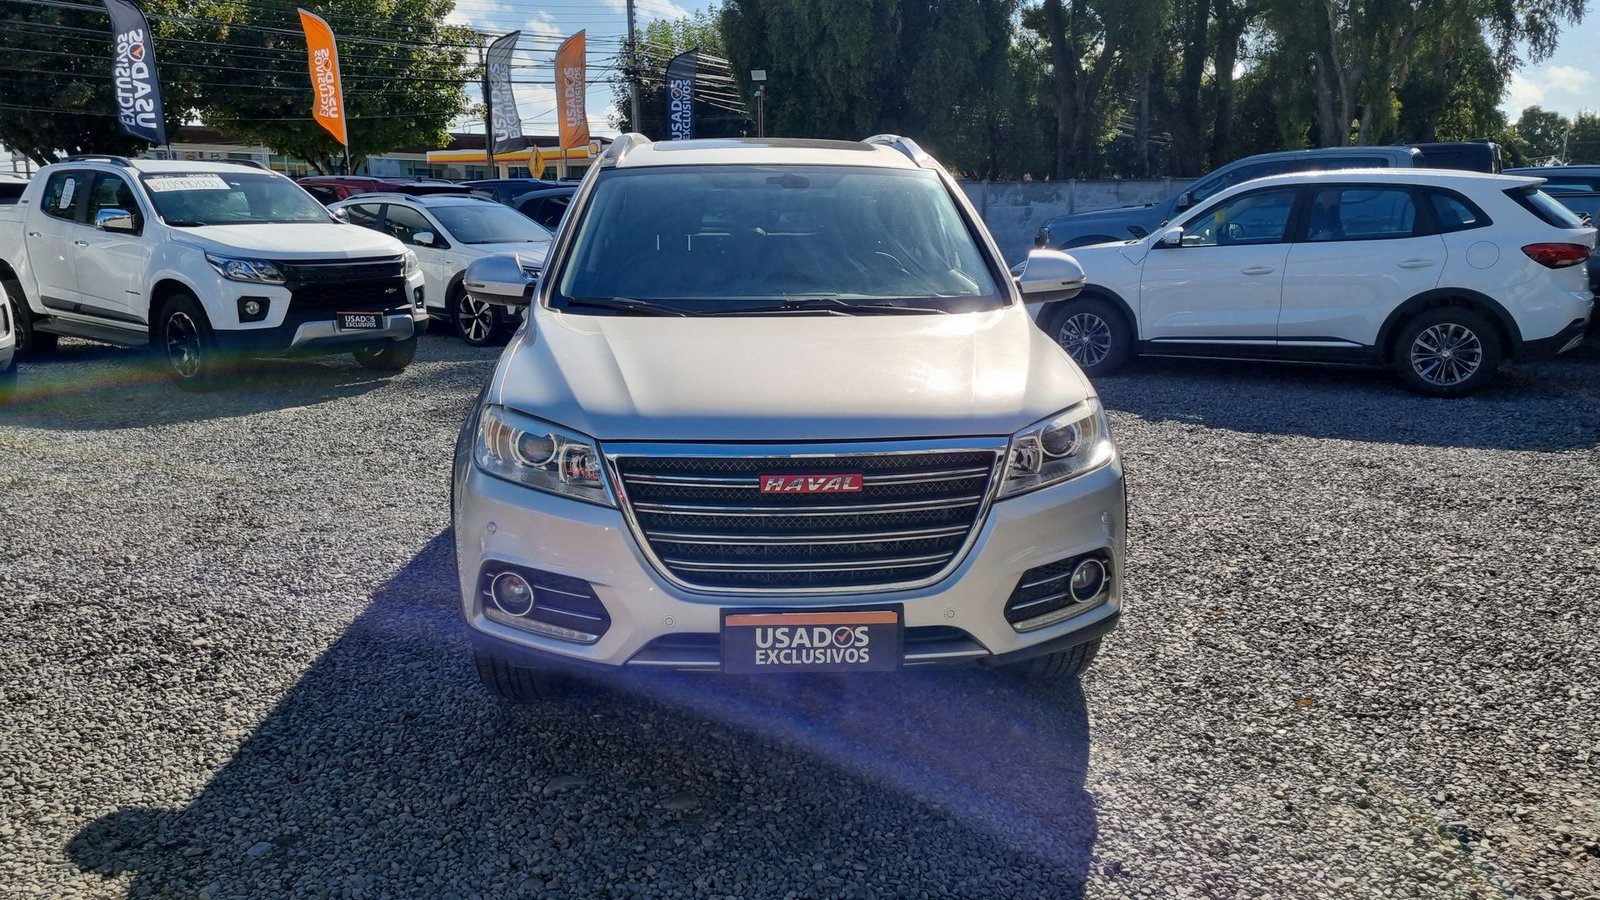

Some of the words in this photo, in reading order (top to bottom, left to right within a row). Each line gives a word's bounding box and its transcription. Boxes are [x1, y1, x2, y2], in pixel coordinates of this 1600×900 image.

[489, 63, 509, 142] USADOS
[500, 63, 521, 139] EXCLUSIVOS
[563, 66, 577, 127] USADOS
[573, 66, 585, 126] EXCLUSIVOS
[671, 80, 683, 140] USADOS
[682, 80, 692, 140] EXCLUSIVOS
[344, 315, 376, 323] USADOS
[763, 476, 861, 492] HAVAL
[755, 626, 870, 648] USADOS
[755, 648, 870, 665] EXCLUSIVOS
